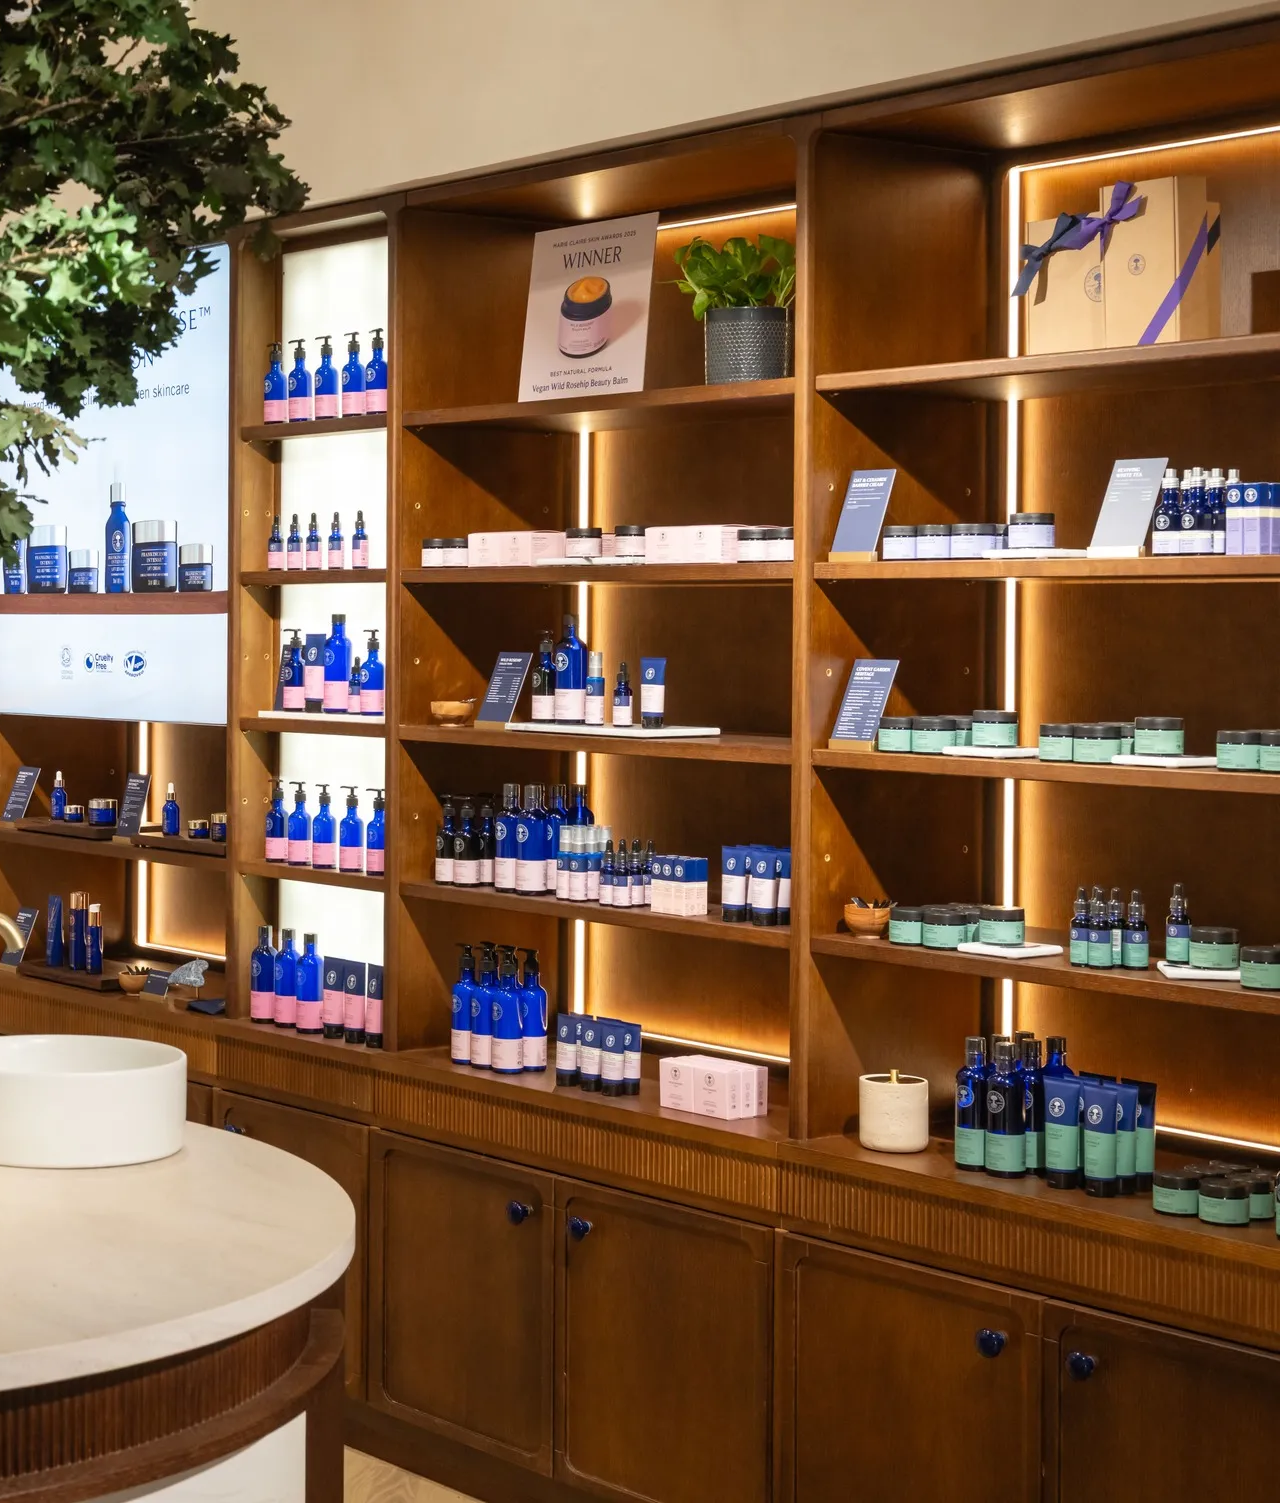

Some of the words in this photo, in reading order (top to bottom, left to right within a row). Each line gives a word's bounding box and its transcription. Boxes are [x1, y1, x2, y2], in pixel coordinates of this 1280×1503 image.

[569, 238, 587, 246] CLAIRE
[588, 236, 600, 244] SKIN
[601, 233, 623, 241] AWARDS
[624, 230, 637, 238] 2025
[563, 246, 622, 270] WINNER
[563, 368, 587, 376] NATURAL
[588, 366, 613, 374] FORMULA
[152, 384, 190, 398] skincare
[532, 384, 550, 394] Vegan
[551, 382, 565, 391] Wild
[566, 380, 590, 390] Rosehip
[590, 378, 611, 387] Beauty
[612, 376, 629, 385] Balm
[94, 653, 114, 663] Cruelty
[95, 662, 107, 670] Free
